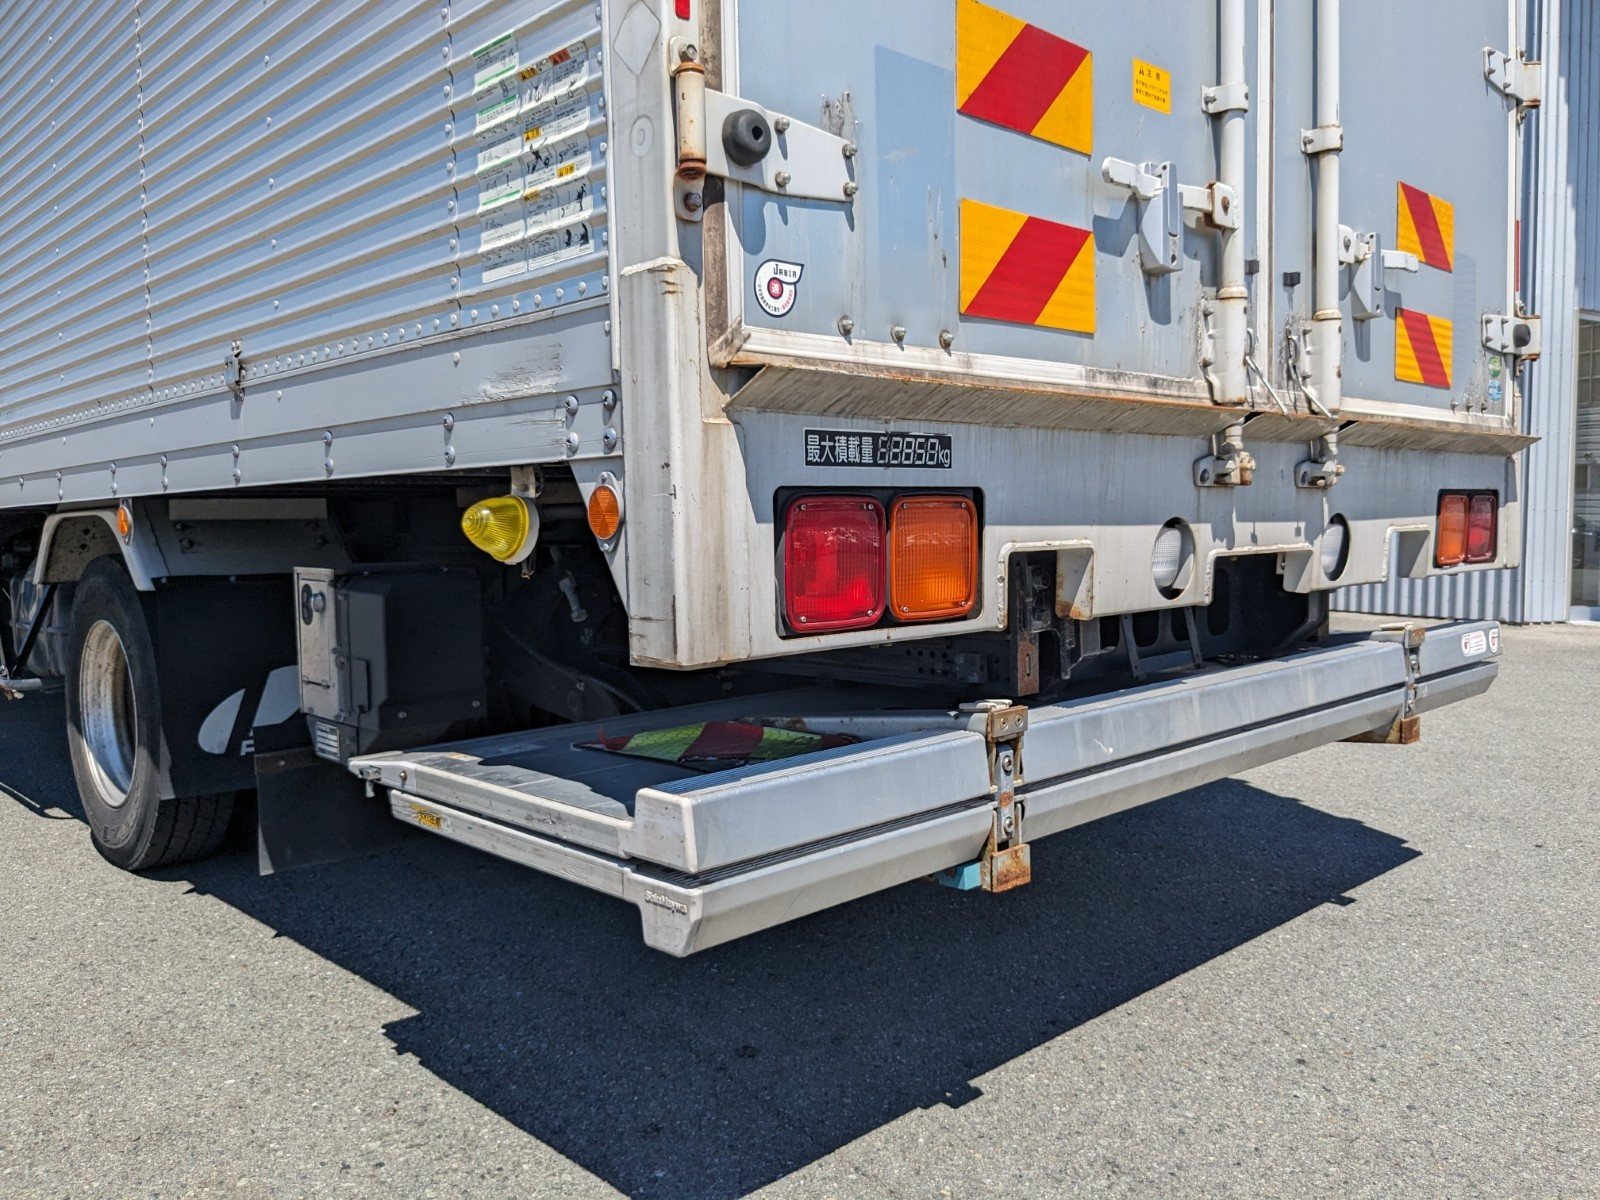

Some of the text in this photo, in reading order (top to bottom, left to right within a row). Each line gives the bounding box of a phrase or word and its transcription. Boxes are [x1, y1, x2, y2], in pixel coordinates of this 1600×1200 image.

[806, 434, 874, 464] 最大積載量
